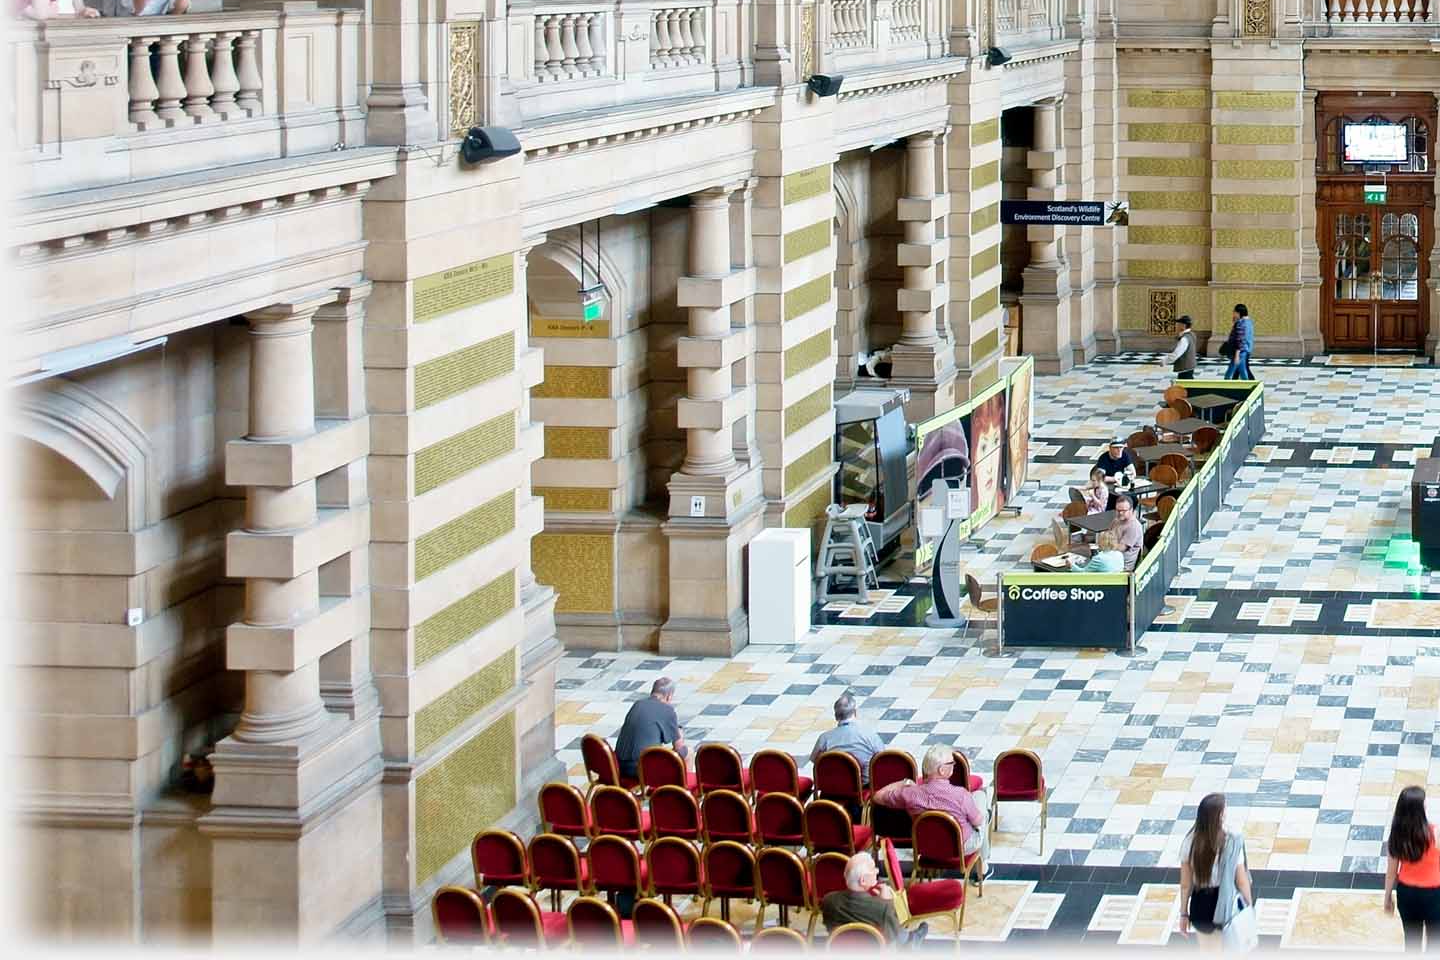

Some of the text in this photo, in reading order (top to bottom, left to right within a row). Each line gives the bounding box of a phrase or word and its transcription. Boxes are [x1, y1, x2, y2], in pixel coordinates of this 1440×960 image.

[1047, 205, 1101, 213] Scotland's Wildlife
[1051, 214, 1080, 222] Discovery
[1022, 588, 1104, 602] Coffee Shop
